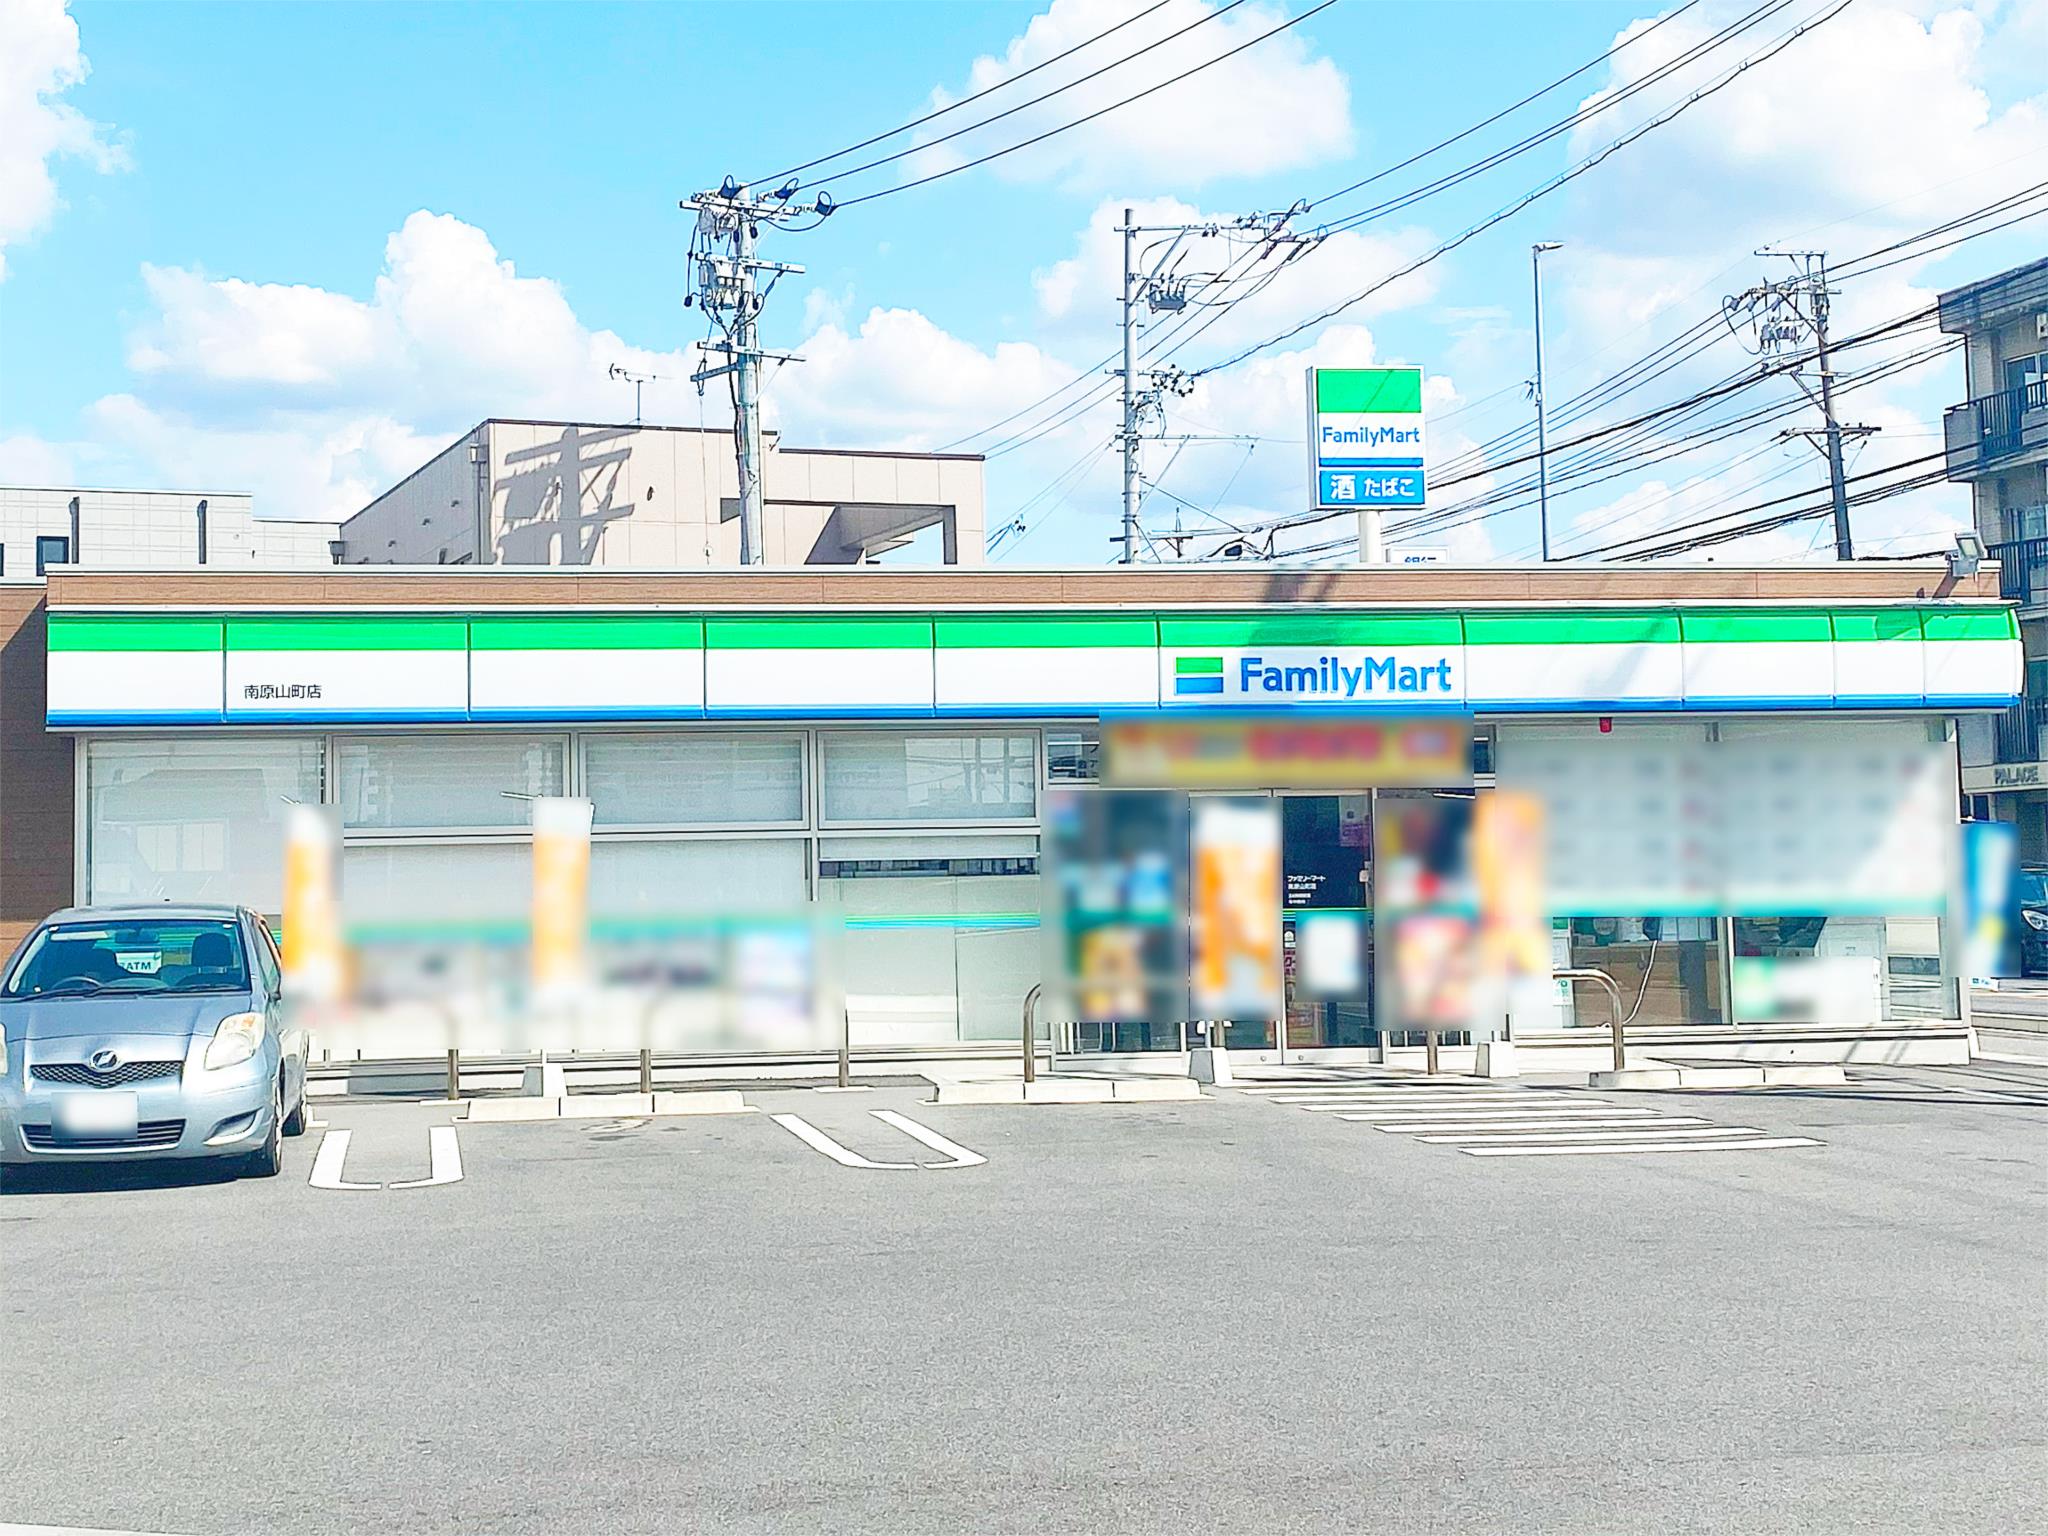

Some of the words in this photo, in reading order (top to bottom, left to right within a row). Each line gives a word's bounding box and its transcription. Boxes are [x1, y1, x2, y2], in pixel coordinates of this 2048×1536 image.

[1322, 426, 1421, 448] FamilyMart
[1330, 474, 1357, 500] 酒
[1363, 477, 1416, 498] たばこ
[1240, 656, 1452, 697] FamilyMart
[244, 684, 322, 700] 南原山町店
